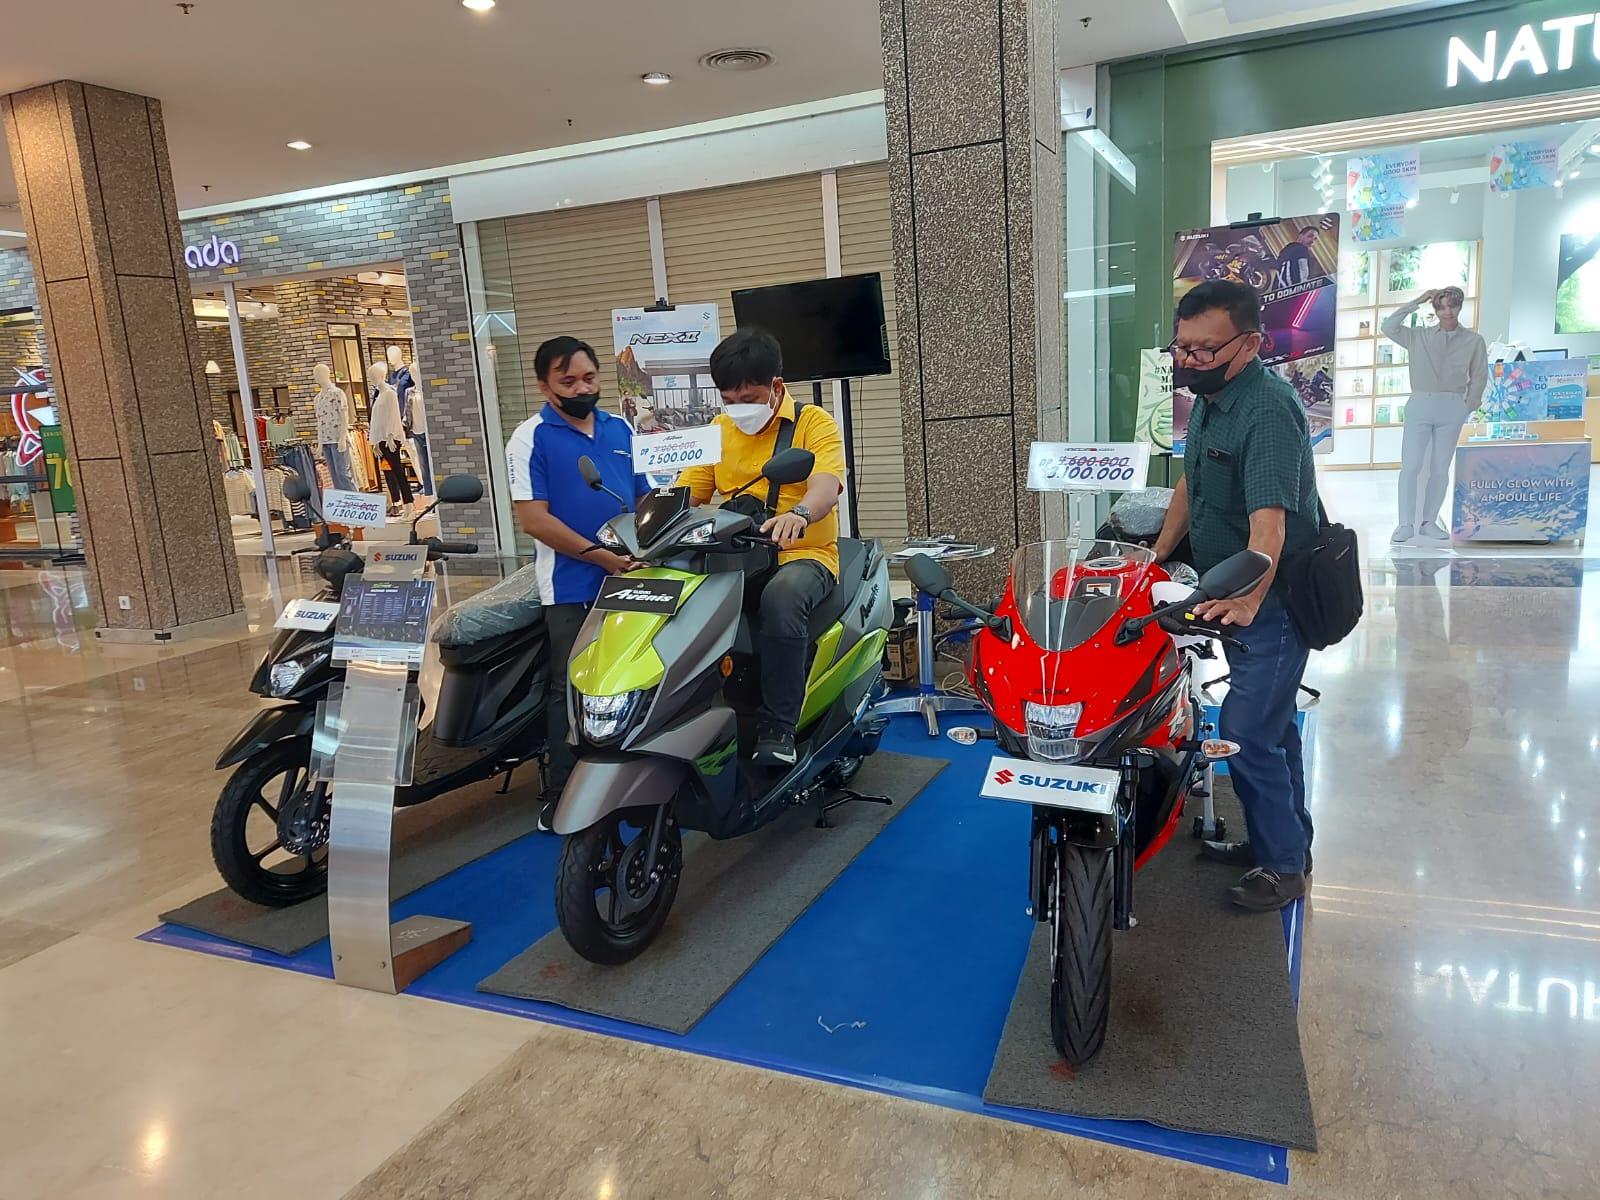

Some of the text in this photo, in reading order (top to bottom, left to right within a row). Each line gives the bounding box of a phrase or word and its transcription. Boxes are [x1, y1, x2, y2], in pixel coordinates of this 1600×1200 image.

[1446, 12, 1600, 88] NAT
[1385, 159, 1417, 170] EVERYDAY
[1263, 279, 1323, 303] TO DOMINATE
[648, 448, 703, 466] 2500.000
[1470, 479, 1574, 489] FULLY GLOW WITH
[1481, 492, 1562, 502] AMPOULE LIFE
[384, 553, 418, 562] SUZUKI
[604, 588, 674, 602] Avenis
[294, 610, 332, 621] SUZUKI
[1018, 774, 1107, 794] SUZUKI
